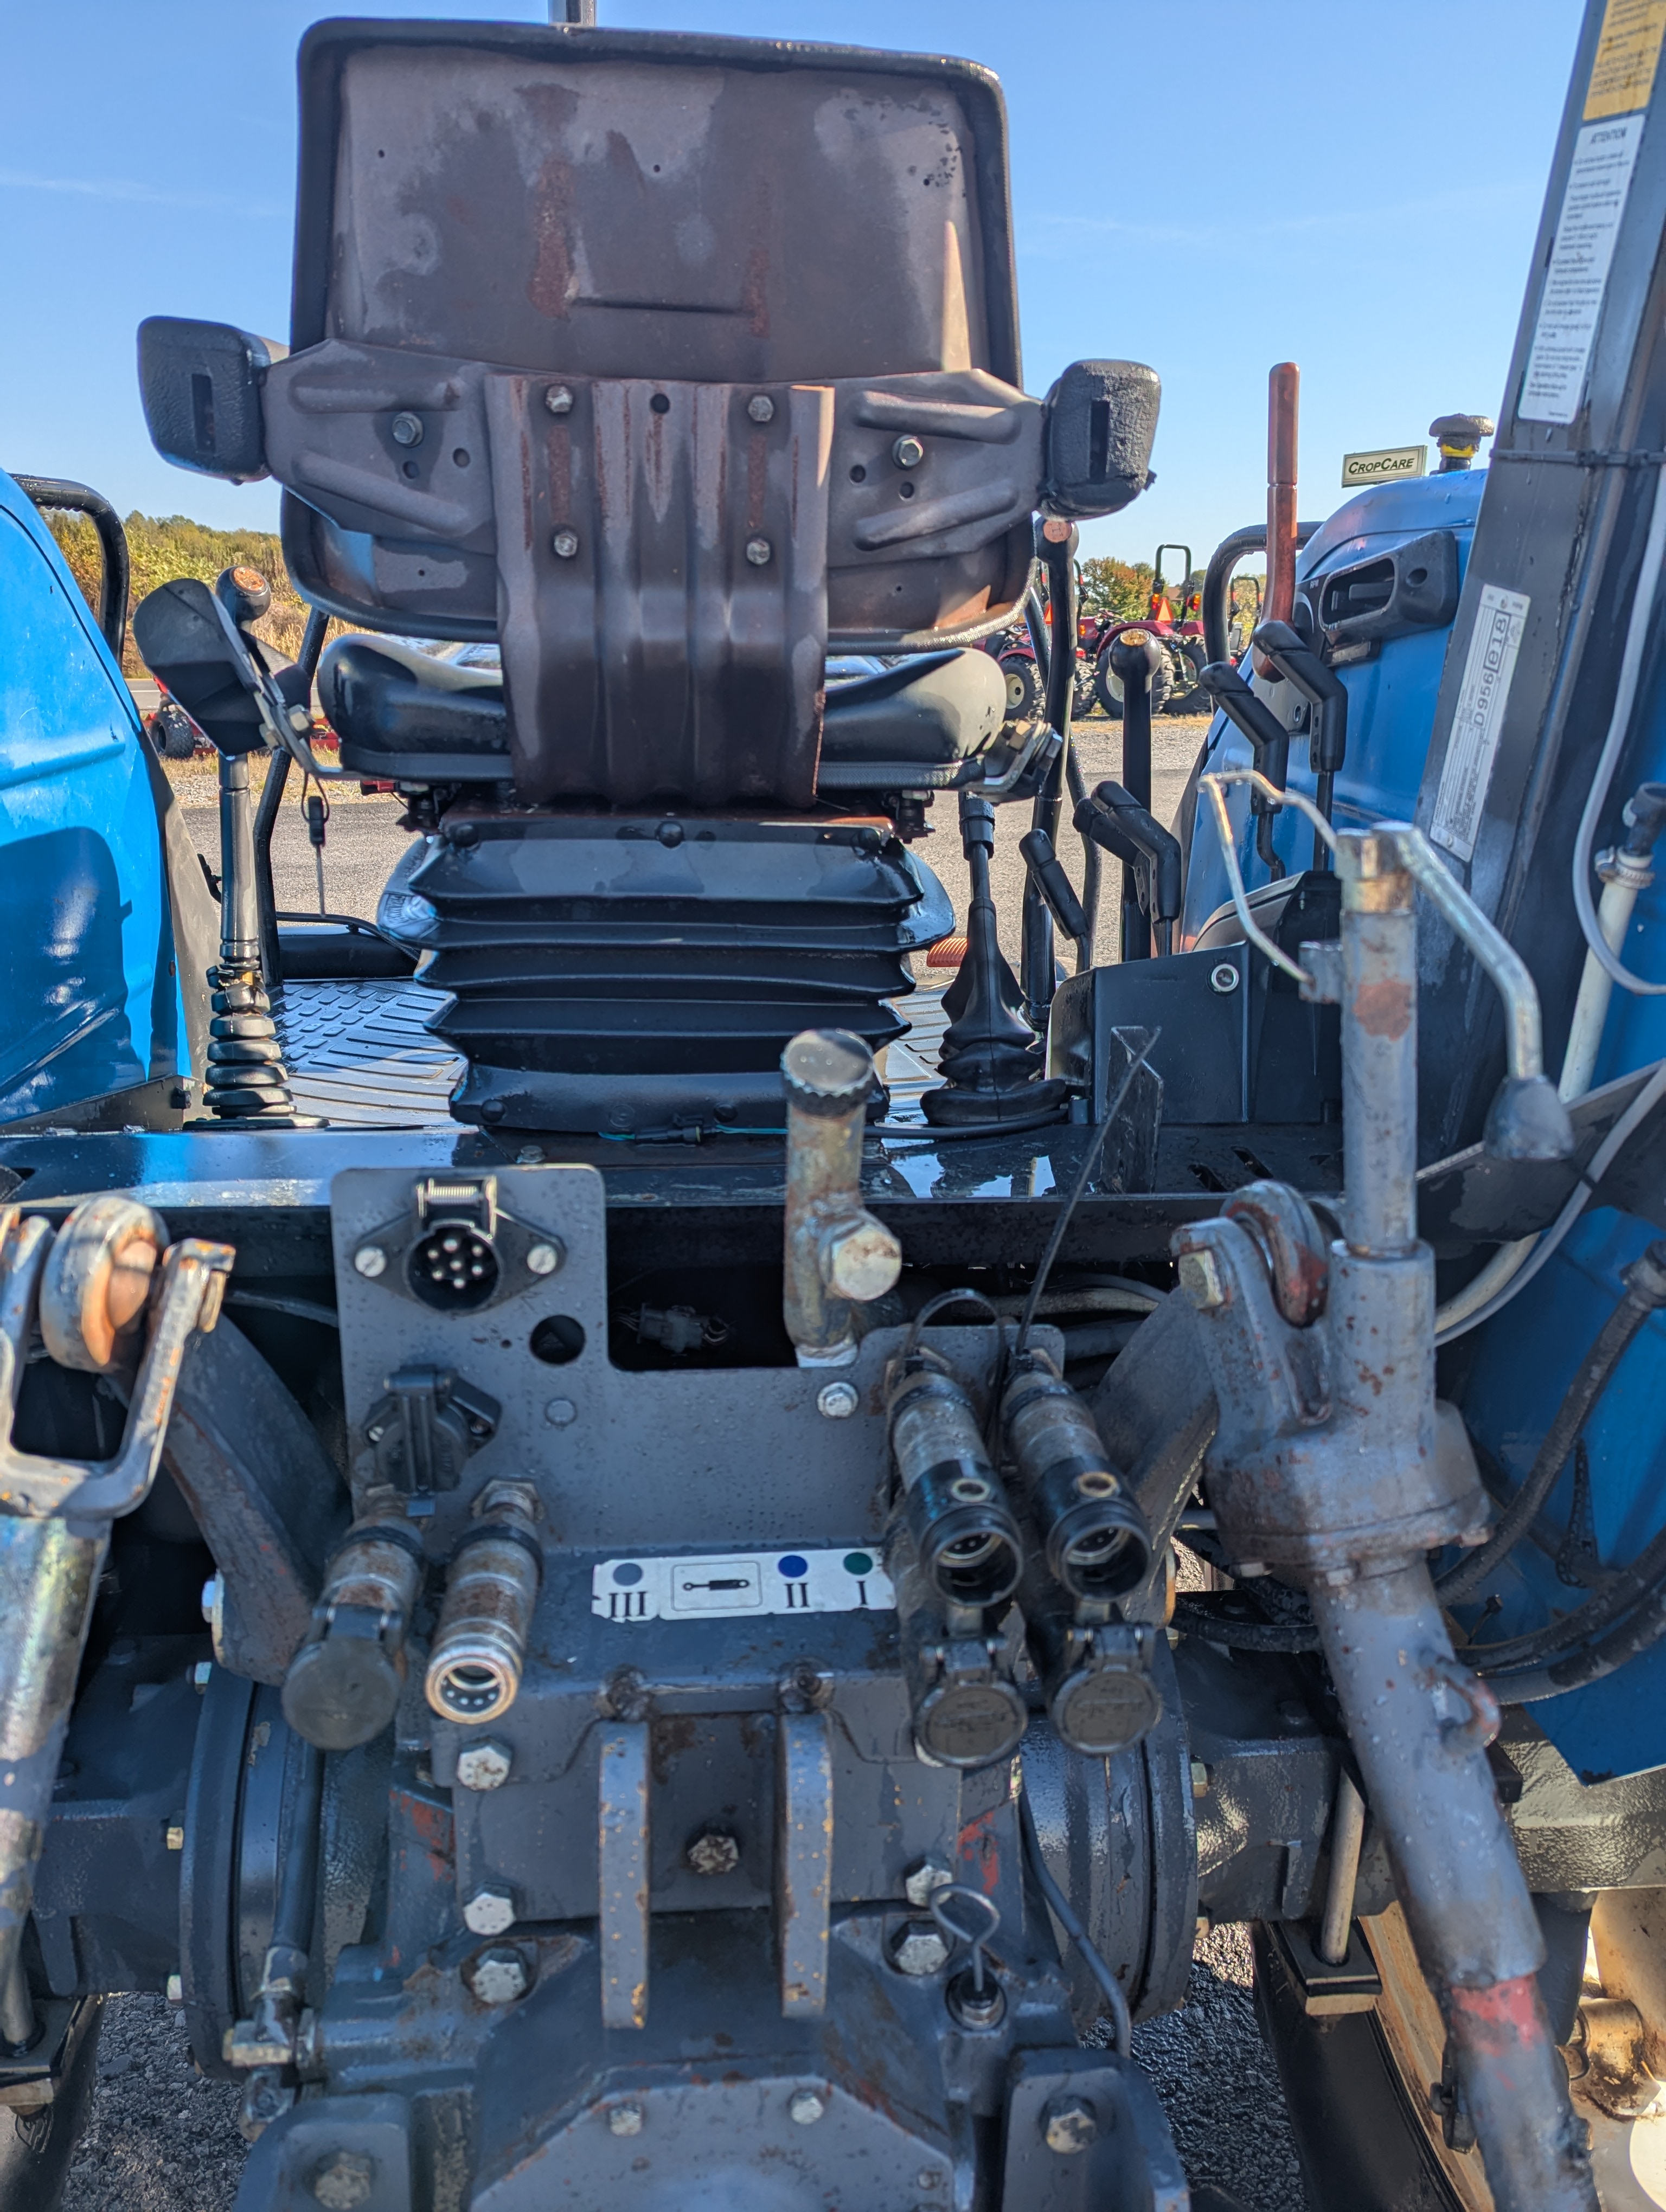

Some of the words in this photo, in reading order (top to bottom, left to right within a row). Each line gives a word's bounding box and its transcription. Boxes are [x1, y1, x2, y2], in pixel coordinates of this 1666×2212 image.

[1473, 672, 1495, 727] D956
[608, 1591, 647, 1618] III
[784, 1583, 809, 1608] II
[857, 1580, 867, 1607] I
